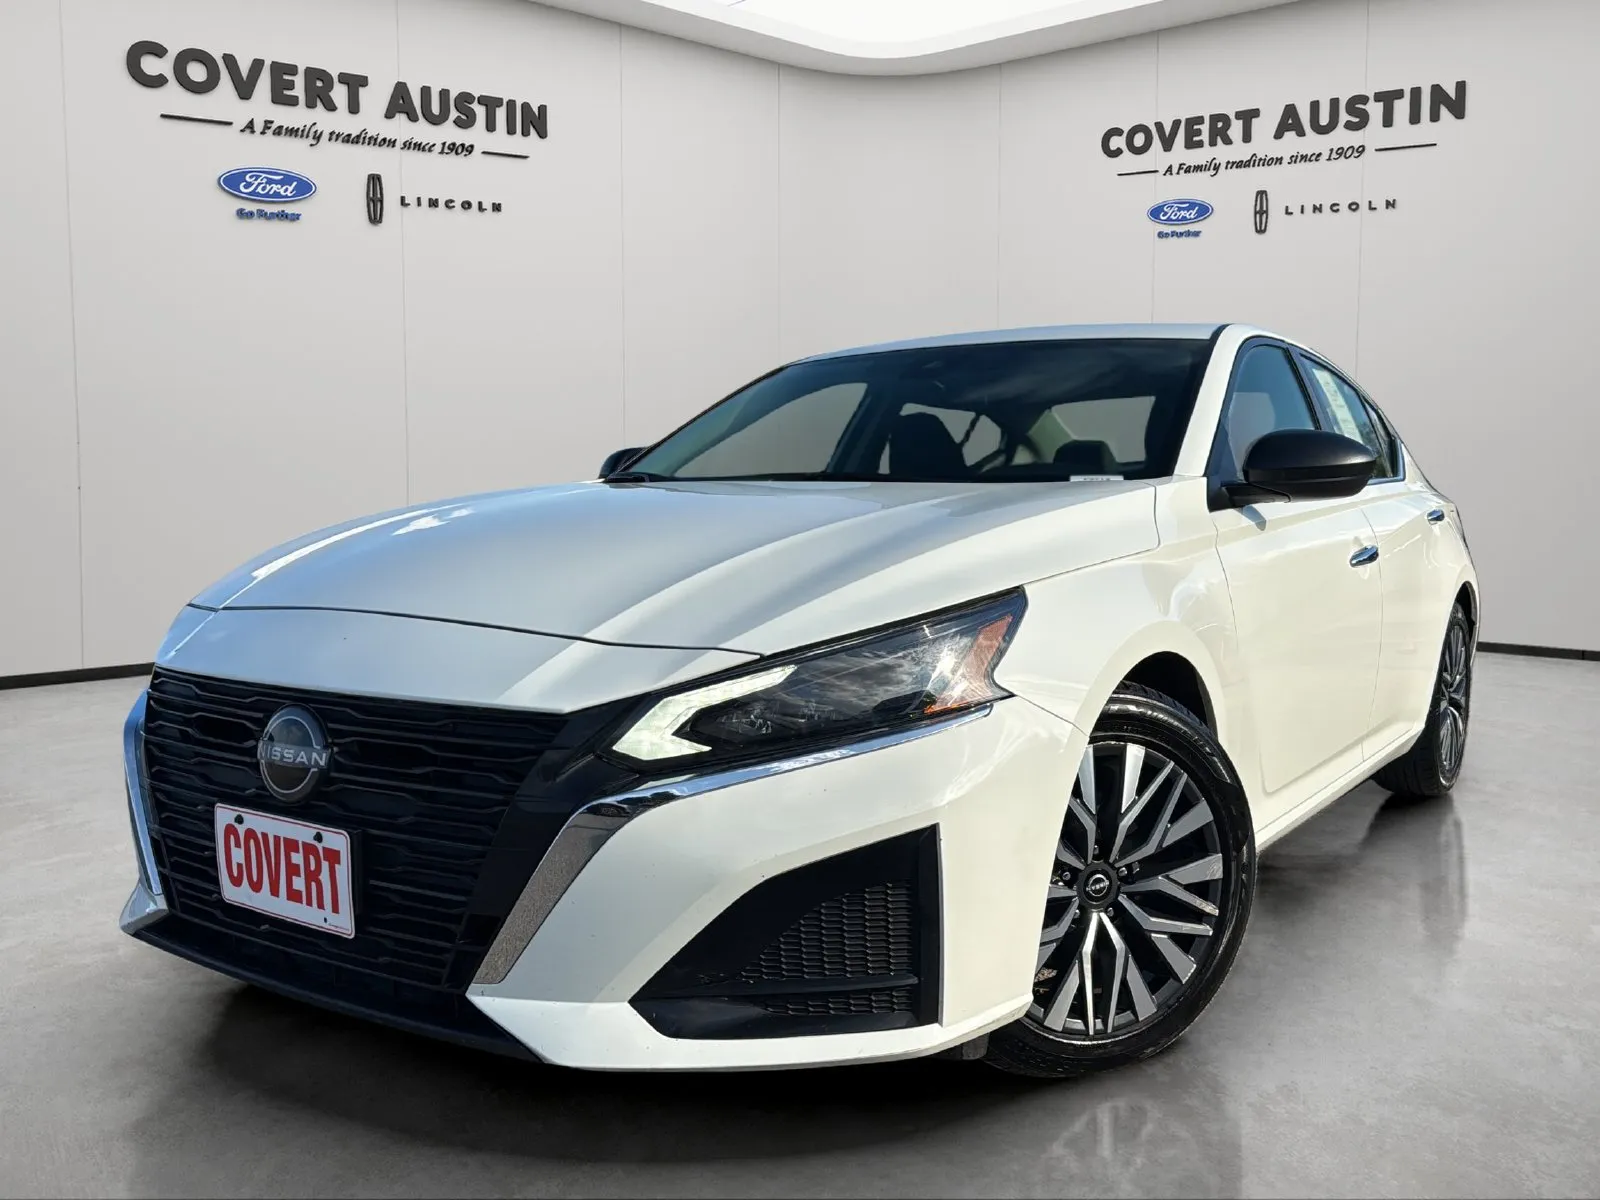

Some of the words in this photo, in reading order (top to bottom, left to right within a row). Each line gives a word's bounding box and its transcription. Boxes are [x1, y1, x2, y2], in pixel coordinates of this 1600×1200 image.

[126, 40, 368, 114] COVERT
[384, 81, 548, 139] AUSTIN
[1101, 108, 1260, 158] COVERT
[1273, 80, 1466, 140] AUSTIN
[239, 117, 256, 135] A
[259, 119, 324, 147] Family
[327, 128, 398, 149] tradition
[400, 137, 436, 153] since
[438, 141, 475, 157] 1909
[1162, 163, 1174, 177] A
[1175, 157, 1221, 177] Family
[1225, 152, 1284, 170] tradition
[1287, 151, 1323, 165] since
[1325, 144, 1366, 162] 1909
[239, 171, 298, 197] Ford
[400, 195, 502, 213] LINCOLN
[1159, 203, 1199, 220] Ford
[1284, 198, 1397, 216] LINCOLN
[258, 743, 327, 767] NISSAN
[223, 823, 341, 914] COVERT
